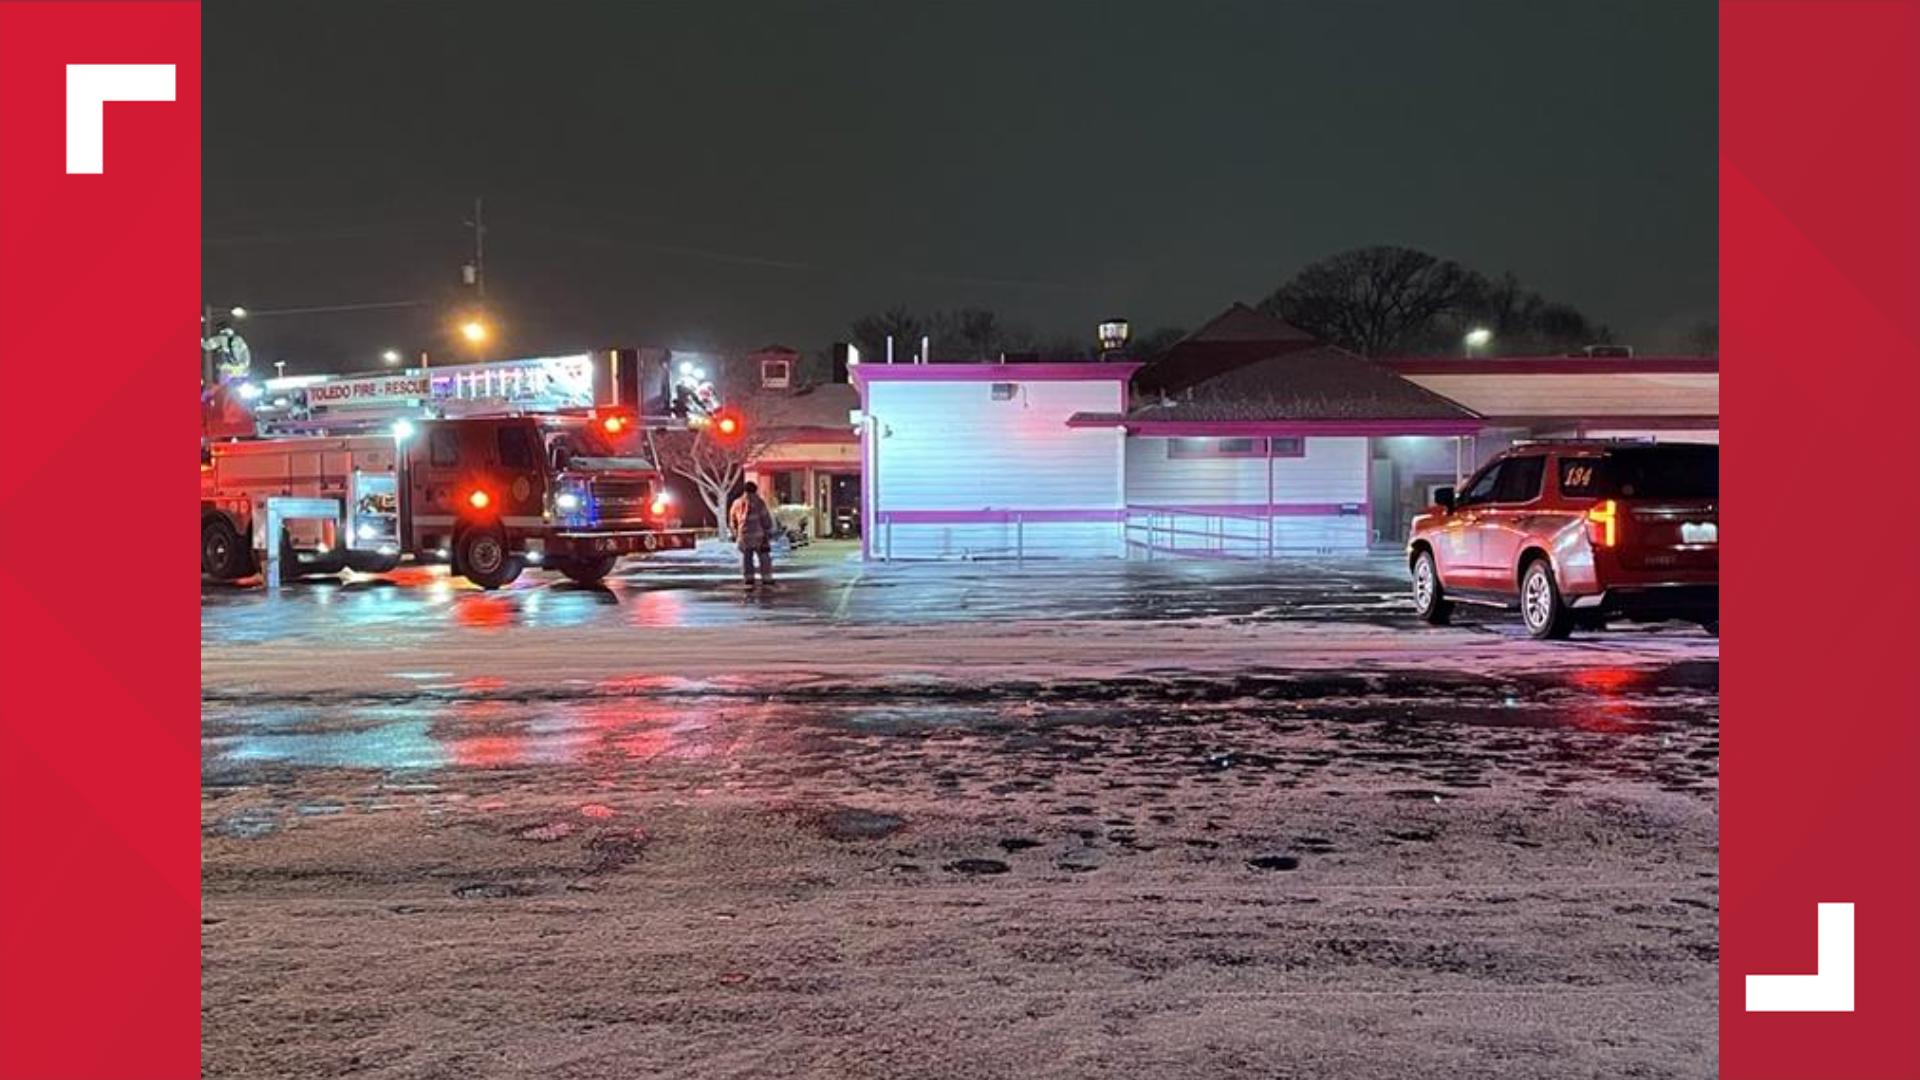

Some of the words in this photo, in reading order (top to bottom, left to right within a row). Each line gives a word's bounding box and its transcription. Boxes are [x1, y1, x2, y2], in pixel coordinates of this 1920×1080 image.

[310, 384, 351, 400] TOLEDO
[353, 382, 376, 396] FIRE
[384, 379, 429, 395] RESCUE
[1564, 466, 1593, 487] 134
